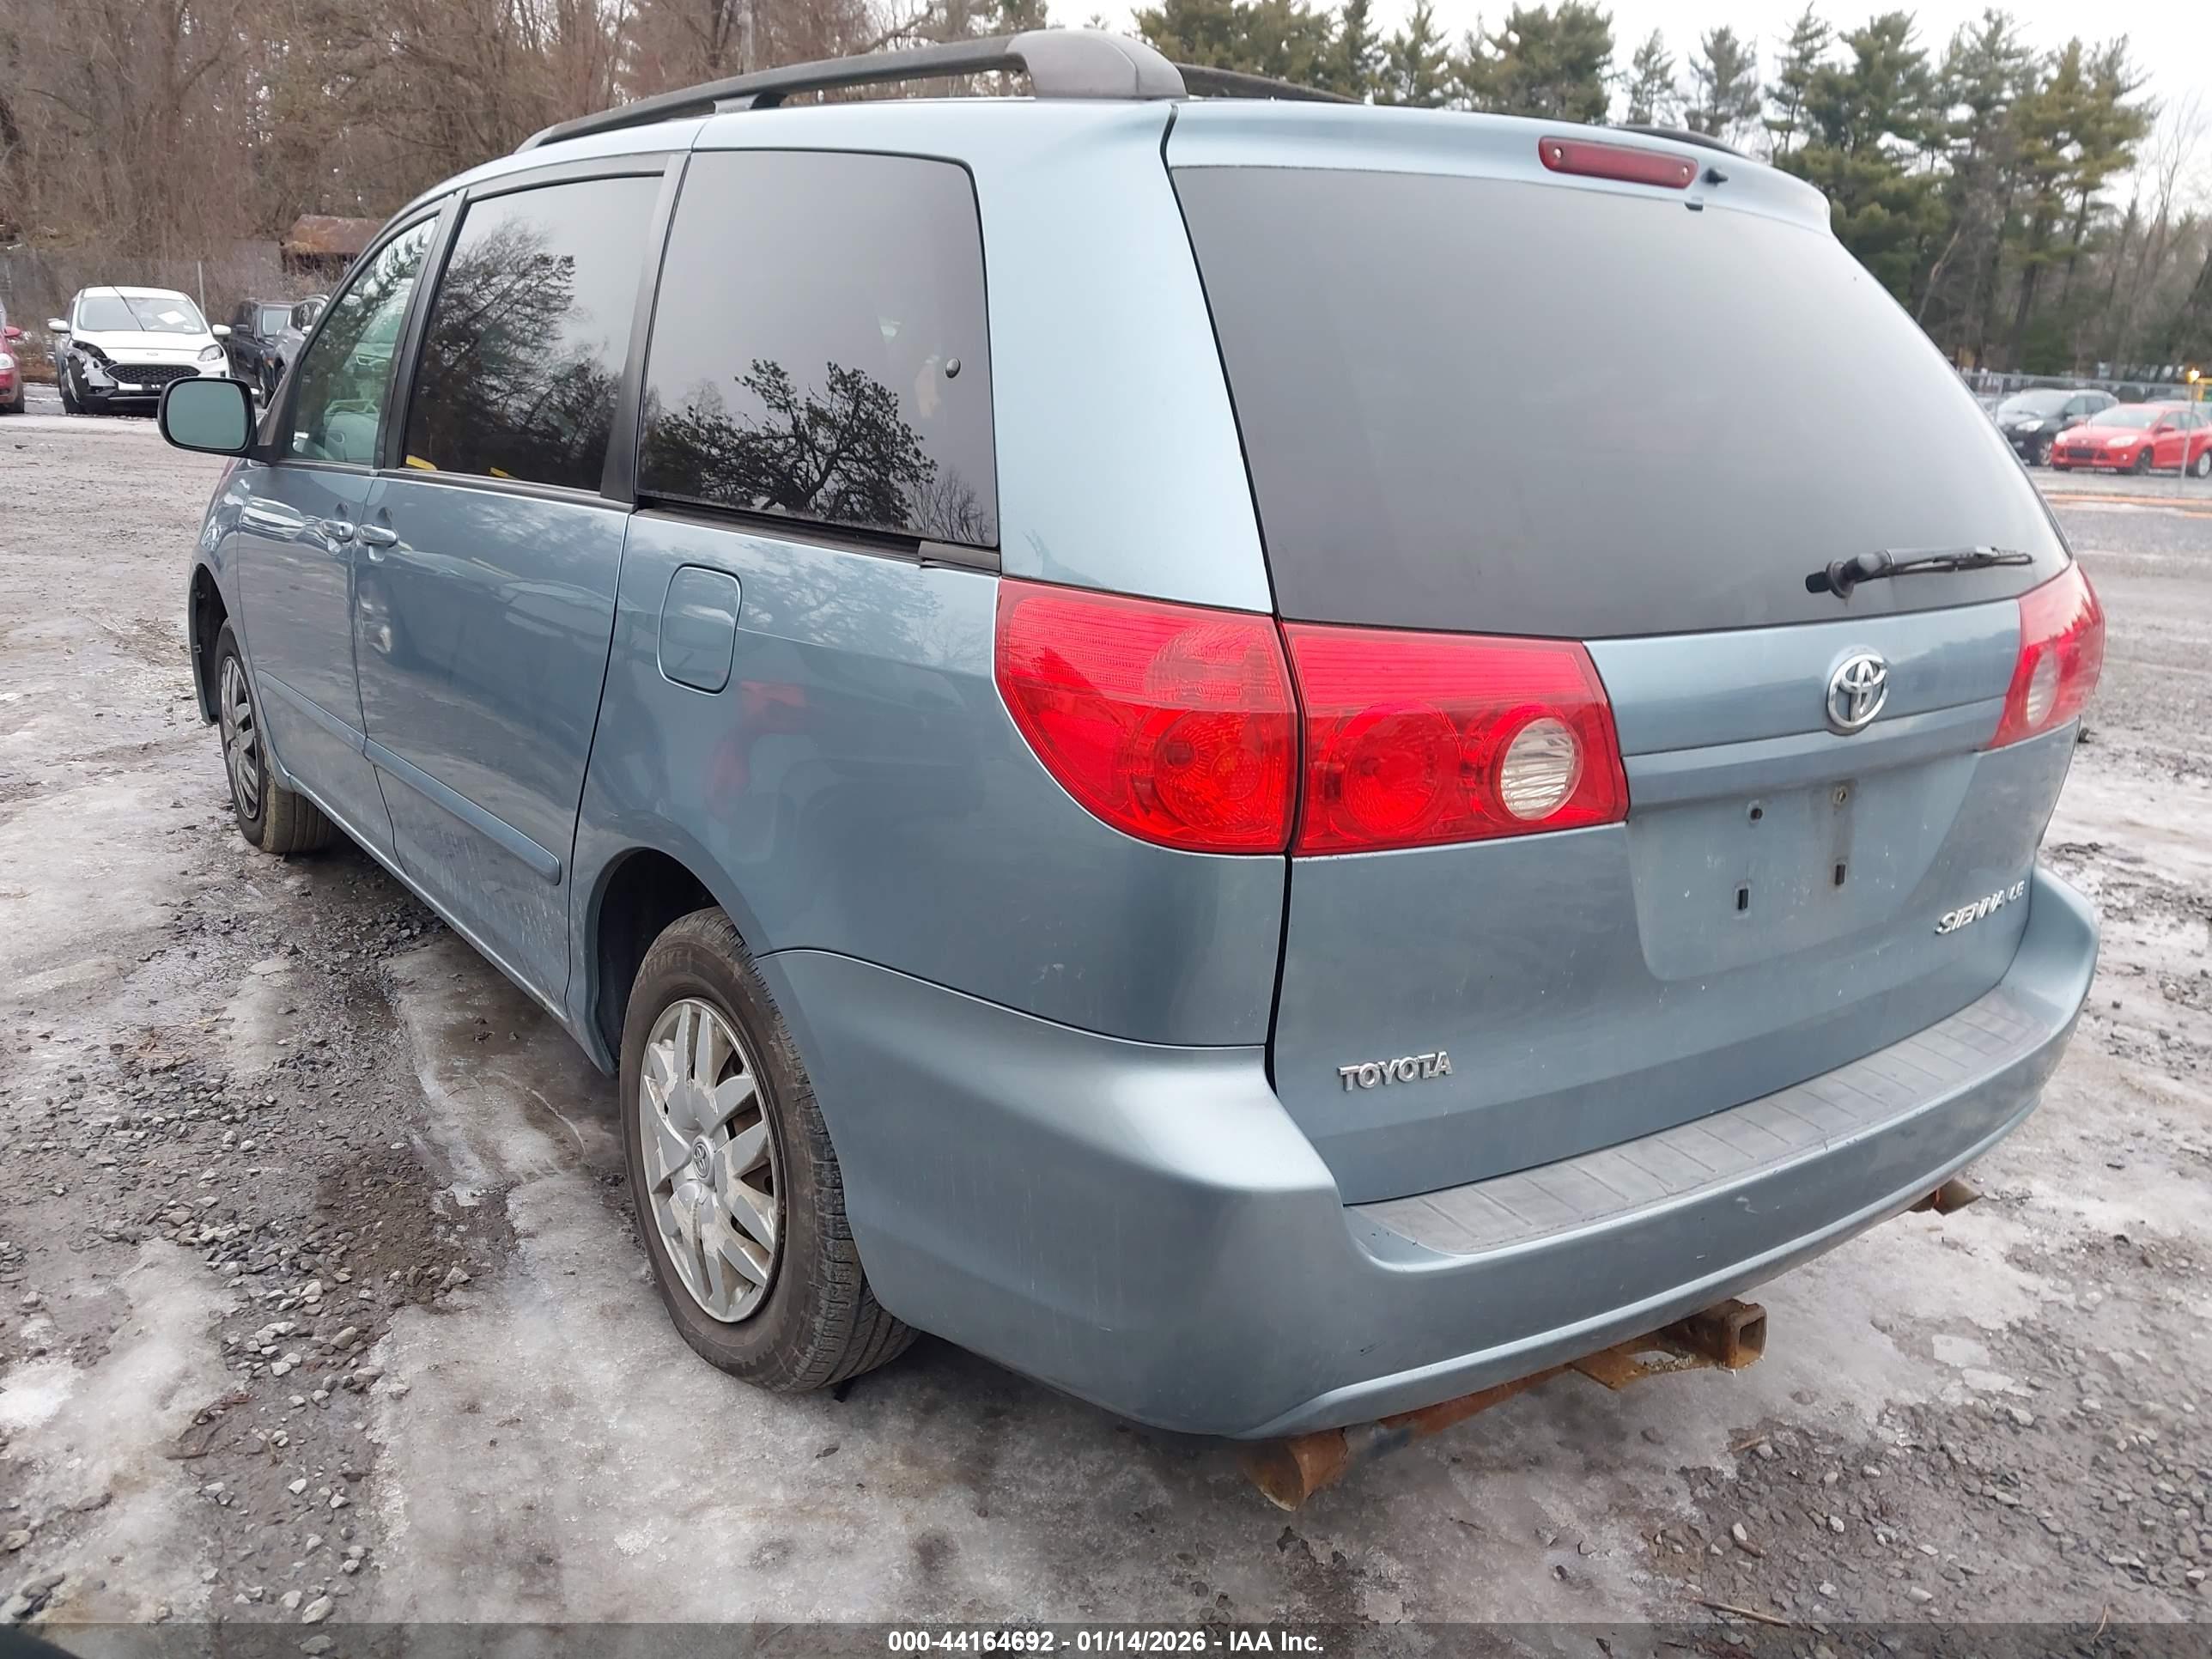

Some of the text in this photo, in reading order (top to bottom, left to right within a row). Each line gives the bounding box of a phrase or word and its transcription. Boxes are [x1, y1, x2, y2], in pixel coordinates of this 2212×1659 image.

[1935, 879, 2026, 934] SIENNA LE
[1338, 1050, 1453, 1092] TOYOTA
